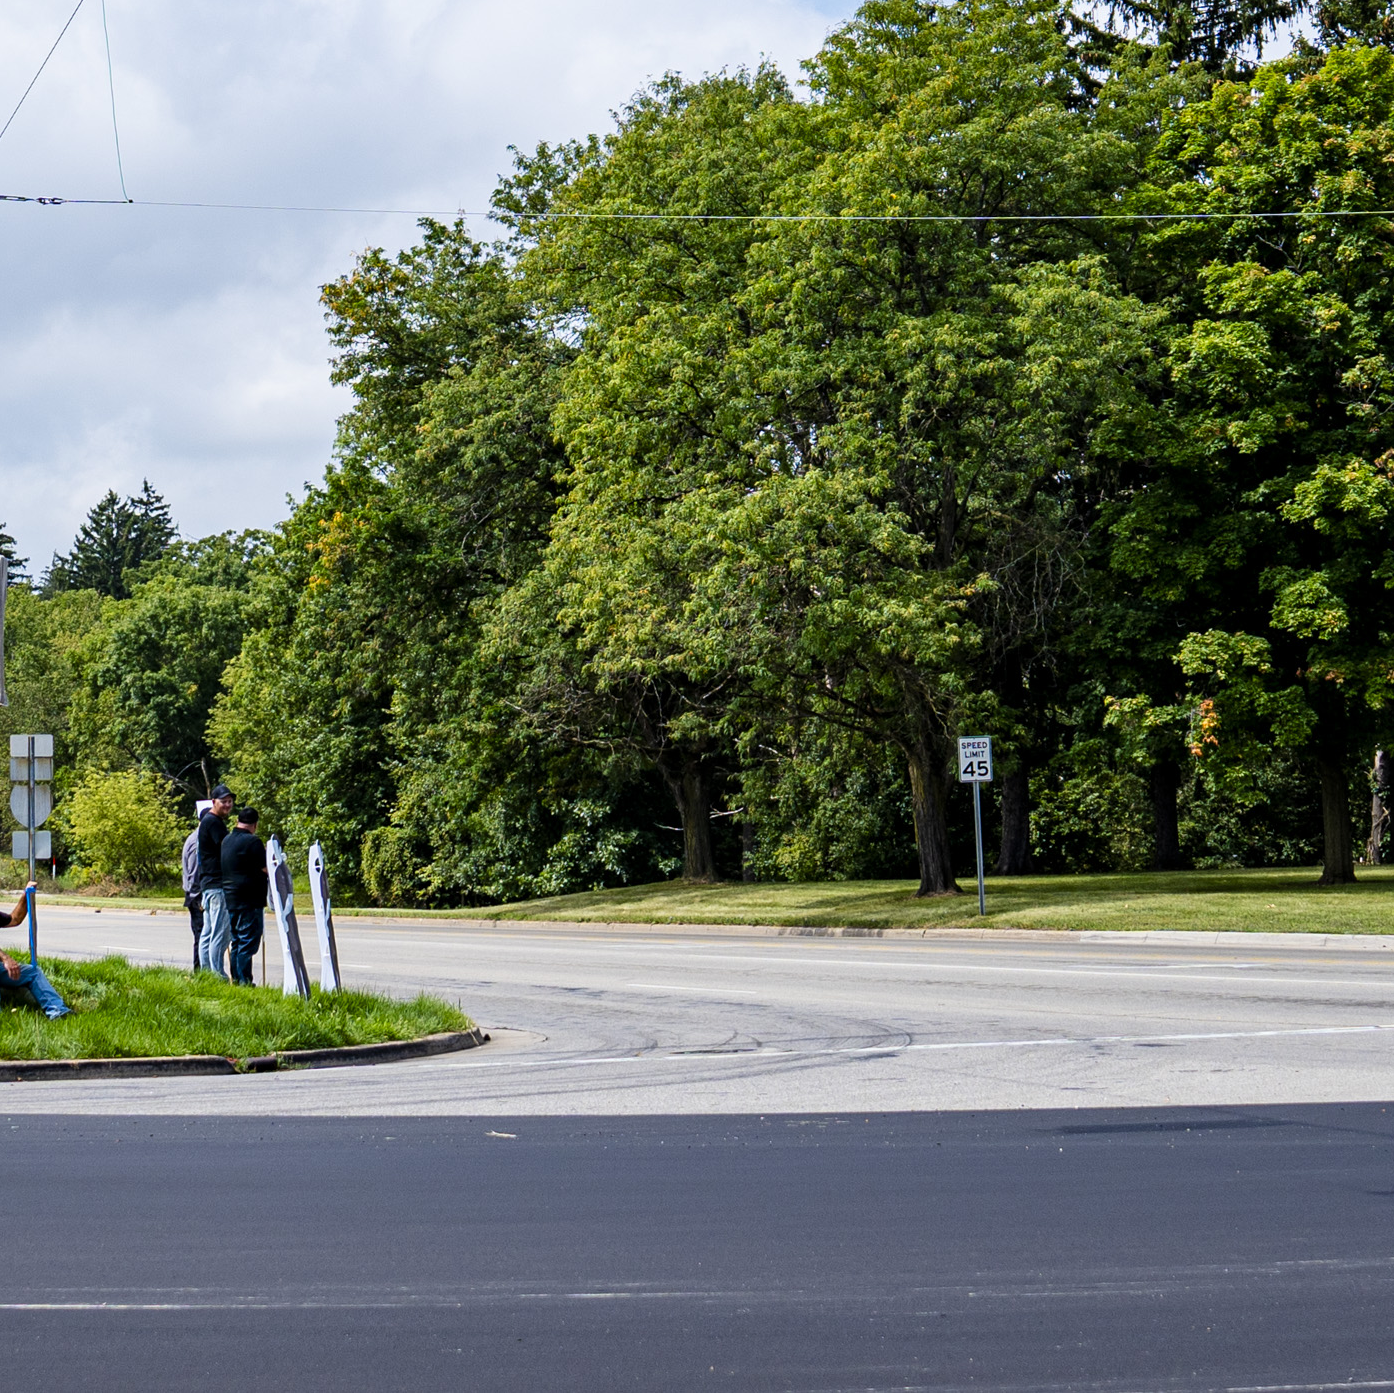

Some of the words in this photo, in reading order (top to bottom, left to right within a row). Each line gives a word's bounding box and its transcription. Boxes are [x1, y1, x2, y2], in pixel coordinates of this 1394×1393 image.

[961, 741, 988, 749] SPEED
[964, 750, 985, 758] LIMIT
[962, 760, 989, 777] 45
